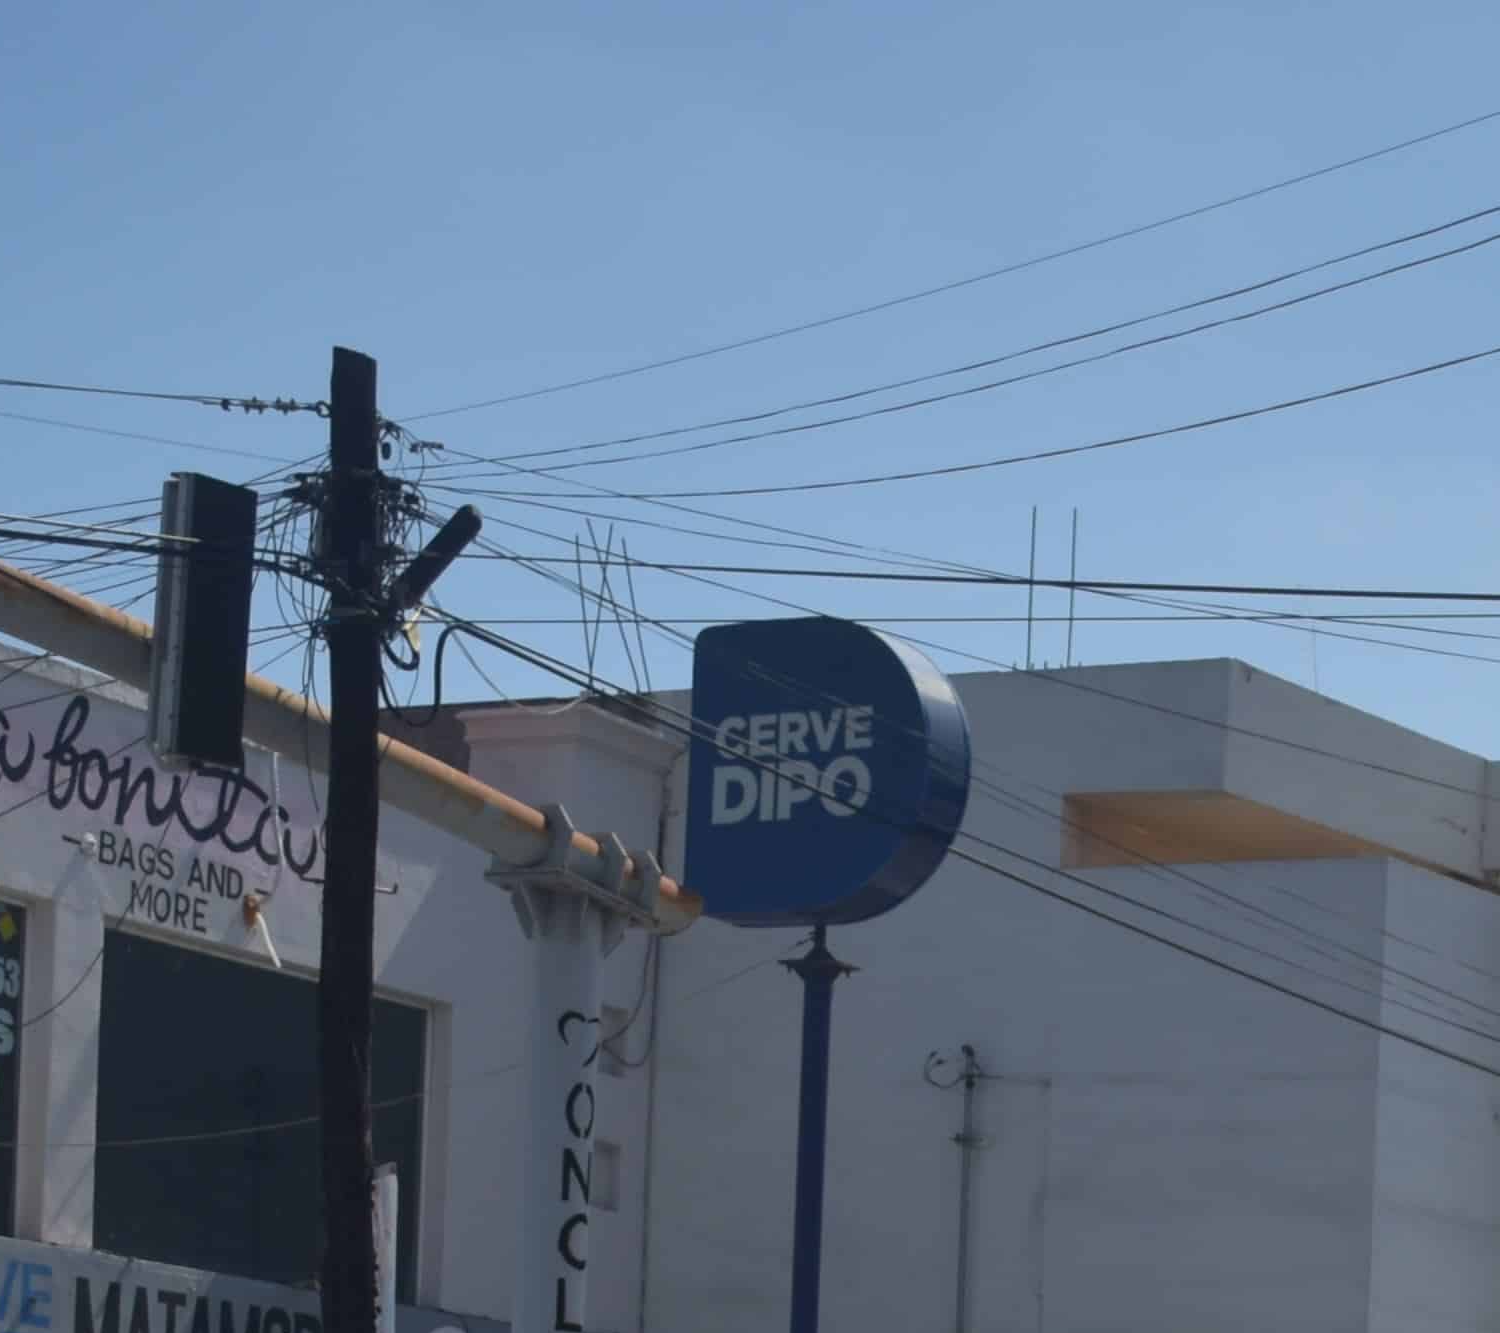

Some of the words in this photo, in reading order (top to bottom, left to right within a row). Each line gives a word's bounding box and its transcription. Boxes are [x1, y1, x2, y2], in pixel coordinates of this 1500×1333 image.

[715, 705, 874, 759] CERVE
[42, 695, 327, 885] bonita
[711, 755, 873, 825] DIPO
[99, 830, 174, 881] BAGS
[188, 857, 244, 899] AND
[130, 878, 208, 934] MORE
